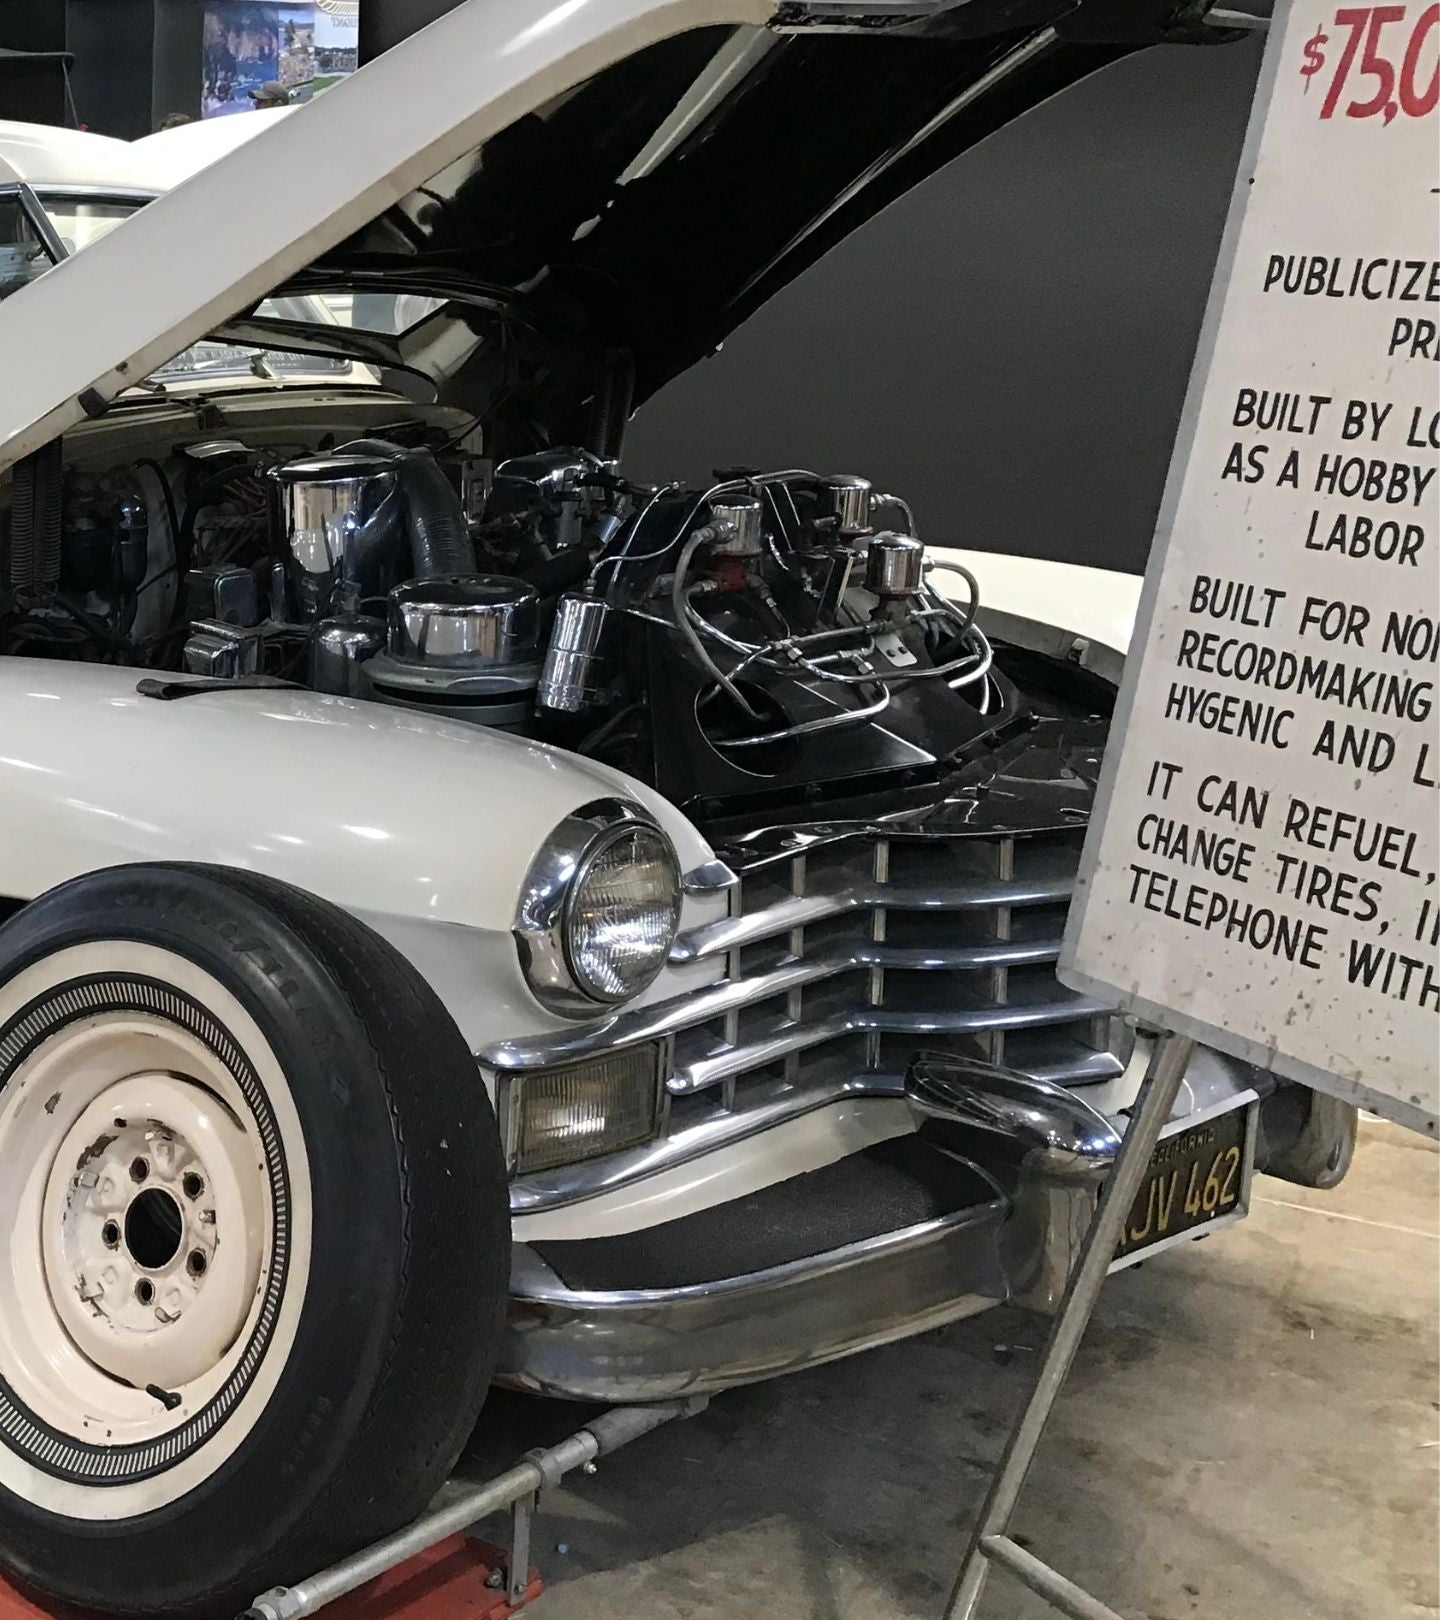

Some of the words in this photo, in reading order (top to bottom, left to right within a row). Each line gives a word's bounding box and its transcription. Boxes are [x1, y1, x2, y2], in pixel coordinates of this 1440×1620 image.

[1232, 388, 1331, 435] BUILT
[1342, 400, 1393, 441] BY
[1222, 443, 1269, 483] AS
[1276, 449, 1300, 489] A
[1314, 453, 1436, 507] HOBBY
[1305, 510, 1425, 567] LABOR
[1189, 575, 1286, 629] BUILT
[1298, 597, 1370, 648] FOR
[1177, 629, 1433, 723] RECORDMAKING
[1164, 683, 1294, 749] HYGENIC
[1312, 720, 1395, 774] AND
[1147, 760, 1184, 801] IT
[1196, 775, 1269, 829] CAN
[1283, 798, 1435, 886] REFUEL,
[1137, 813, 1256, 883] CHANGE
[1276, 854, 1389, 936] TIRES,
[1129, 864, 1328, 969] TELEPHONE
[1184, 1146, 1240, 1216] 462
